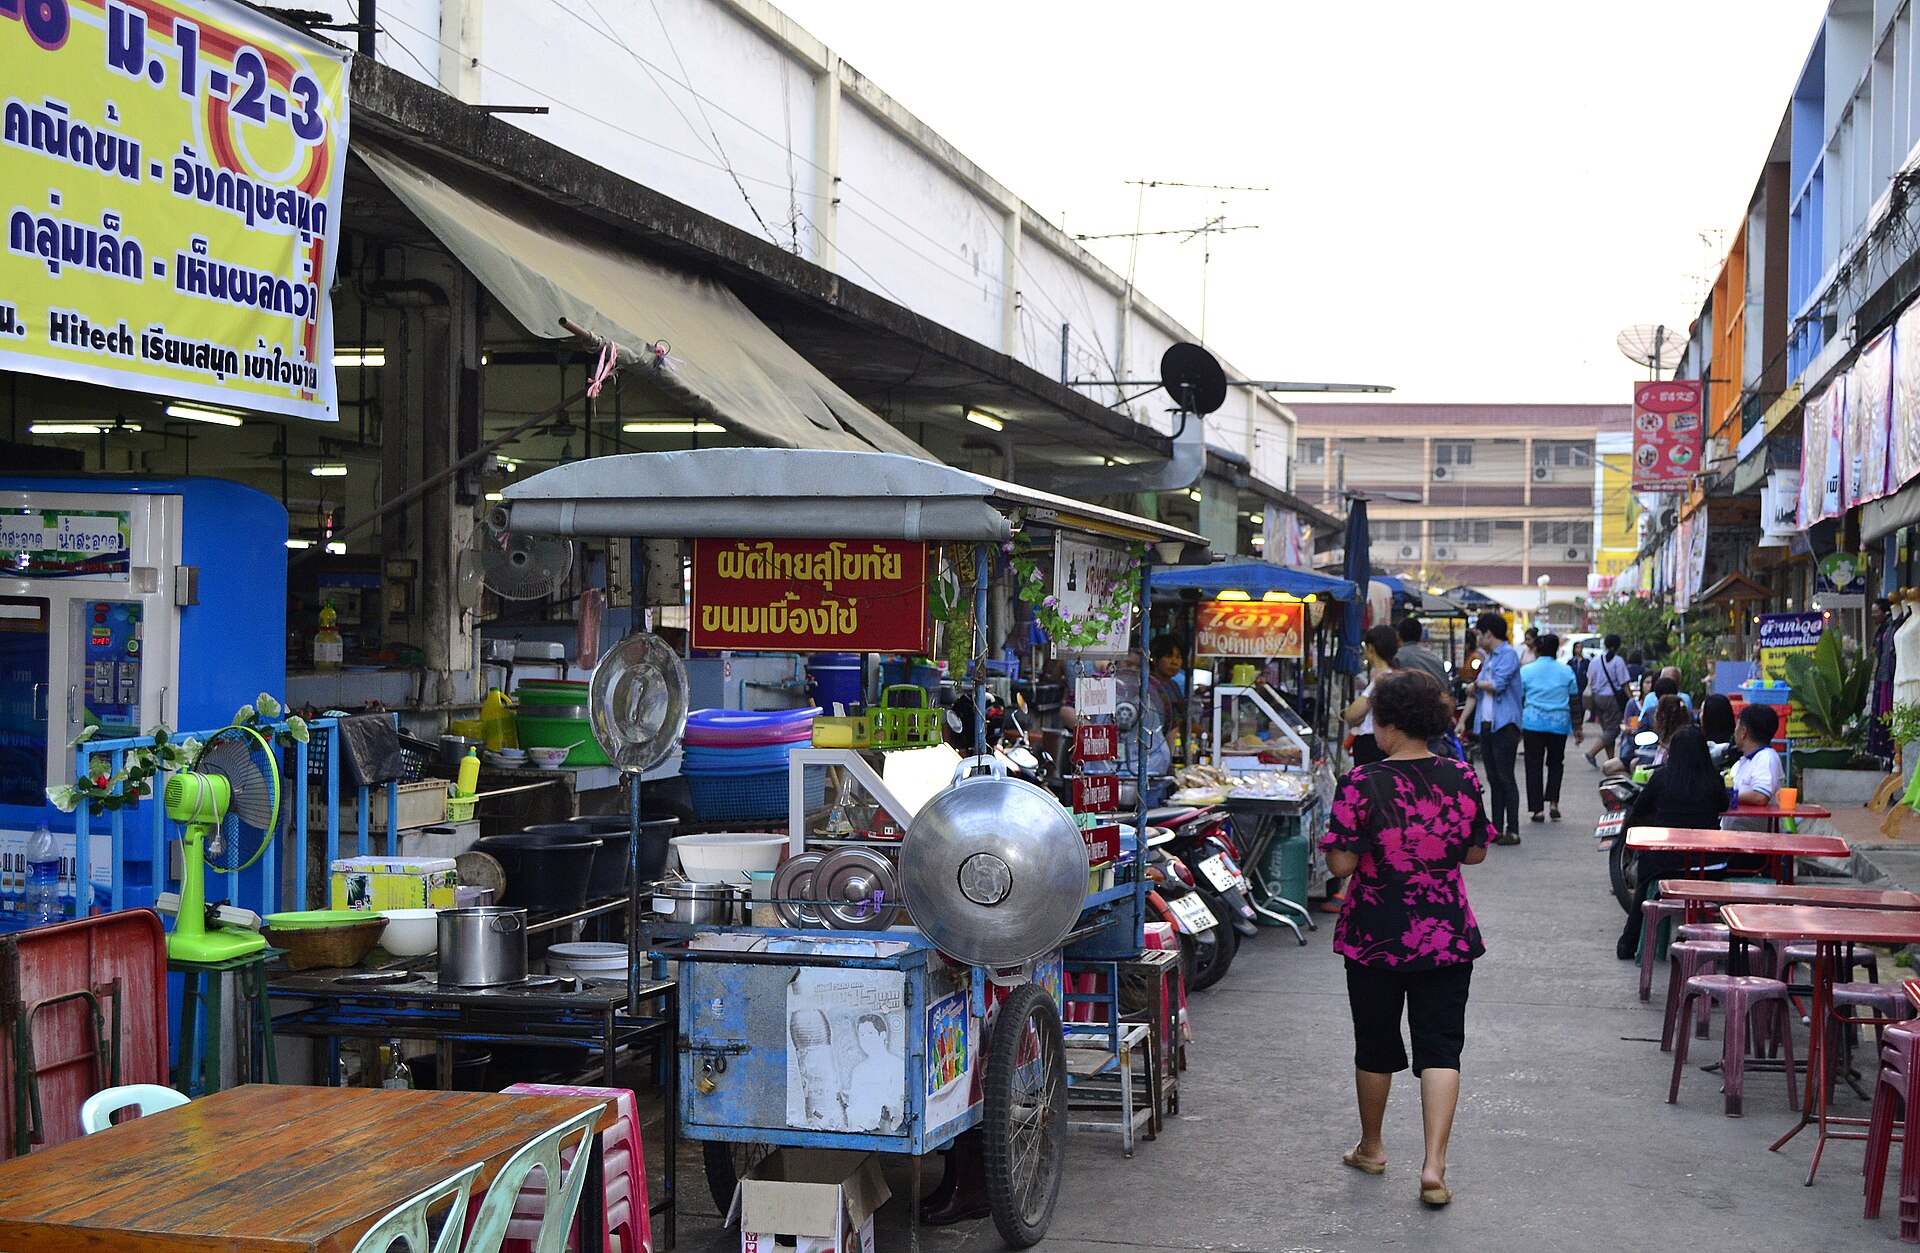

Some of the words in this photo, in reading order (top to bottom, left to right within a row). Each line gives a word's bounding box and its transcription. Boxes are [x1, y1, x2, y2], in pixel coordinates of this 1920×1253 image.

[173, 145, 328, 243] อังกฤษสนุก
[10, 193, 142, 280] กลุ่มเล็ก
[176, 239, 317, 320] เห็นผลกว่า
[50, 312, 133, 356] Hitech
[141, 327, 238, 380] เรียนสนุก
[243, 339, 317, 389] เข้าใจง่าย
[59, 517, 117, 550] น้ำสะอาด
[717, 541, 902, 592] ผัดไทยสุโขทัย
[702, 591, 858, 635] ขนมเบื้องไข่
